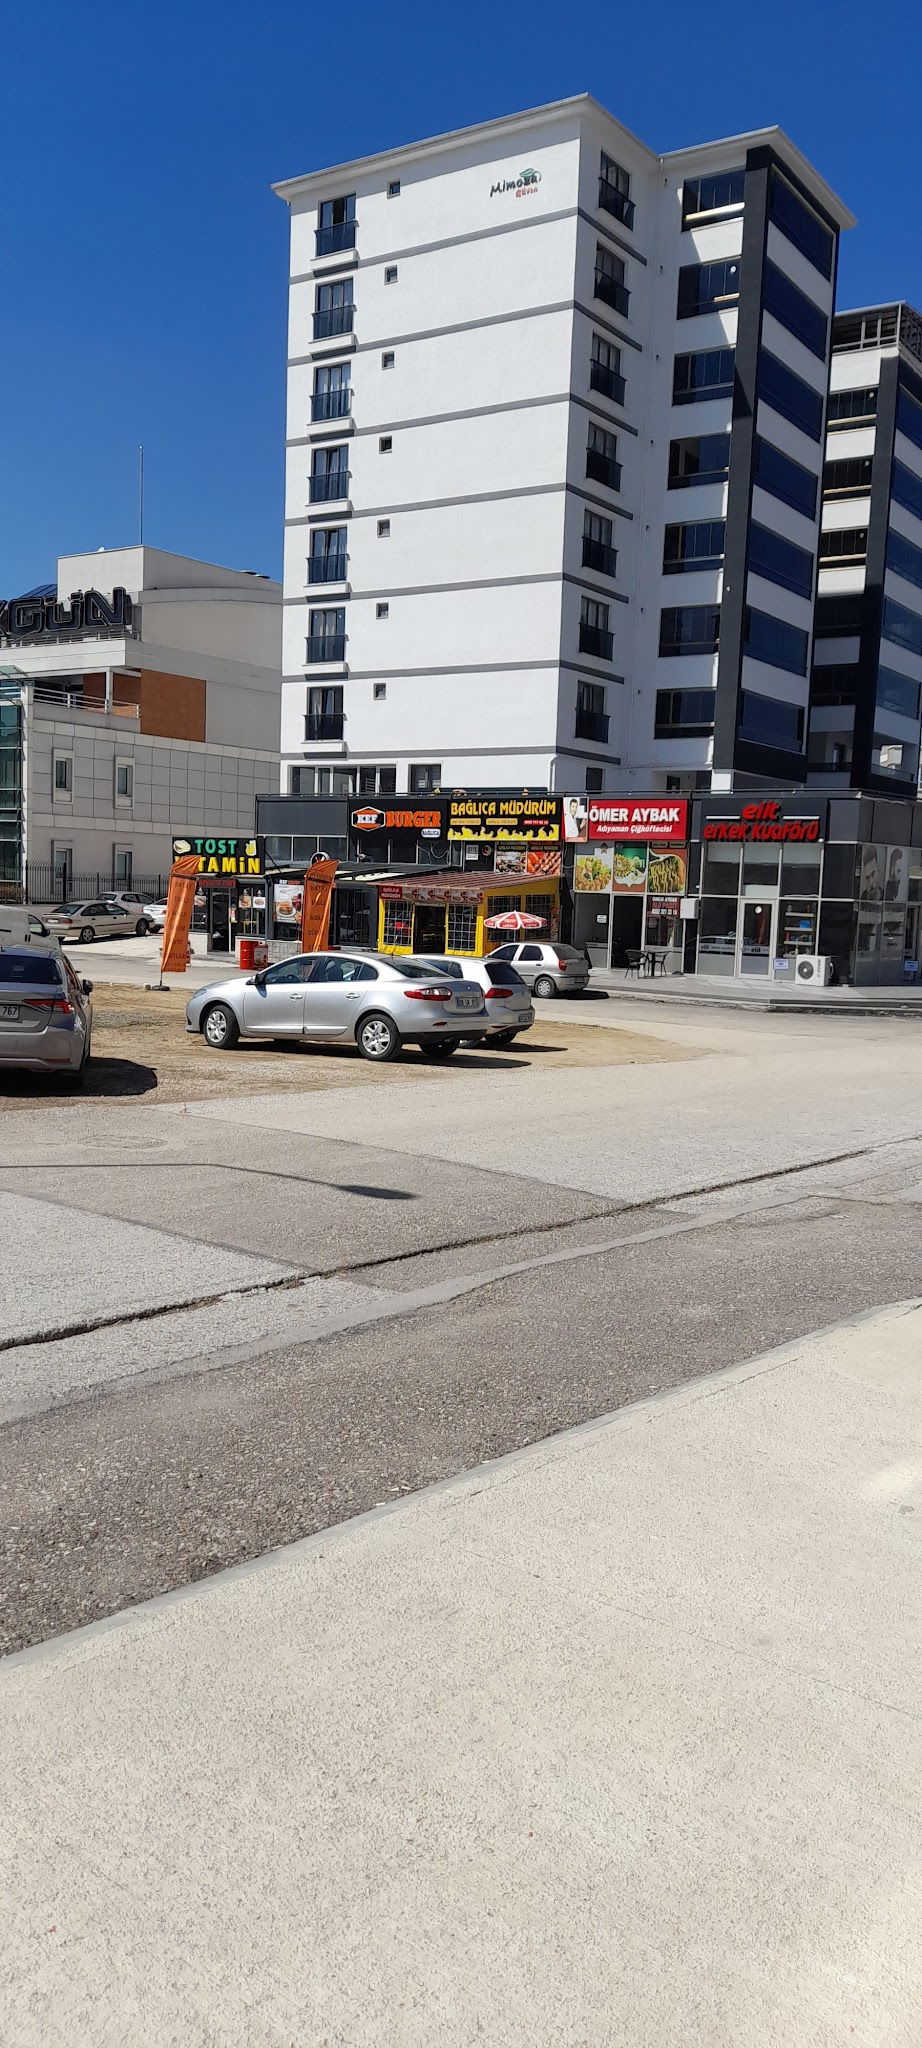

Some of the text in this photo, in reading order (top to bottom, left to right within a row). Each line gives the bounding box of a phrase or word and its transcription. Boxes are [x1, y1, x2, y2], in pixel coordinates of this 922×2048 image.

[0, 586, 128, 637] GÜN
[450, 799, 557, 816] BAĞLICA MÜDÜRÜM
[589, 806, 681, 822] ÖMER AYBAK
[742, 800, 780, 820] elit
[385, 810, 442, 828] BURGER
[704, 823, 748, 840] erkek
[194, 839, 237, 855] TOST
[2, 1006, 17, 1016] 767
